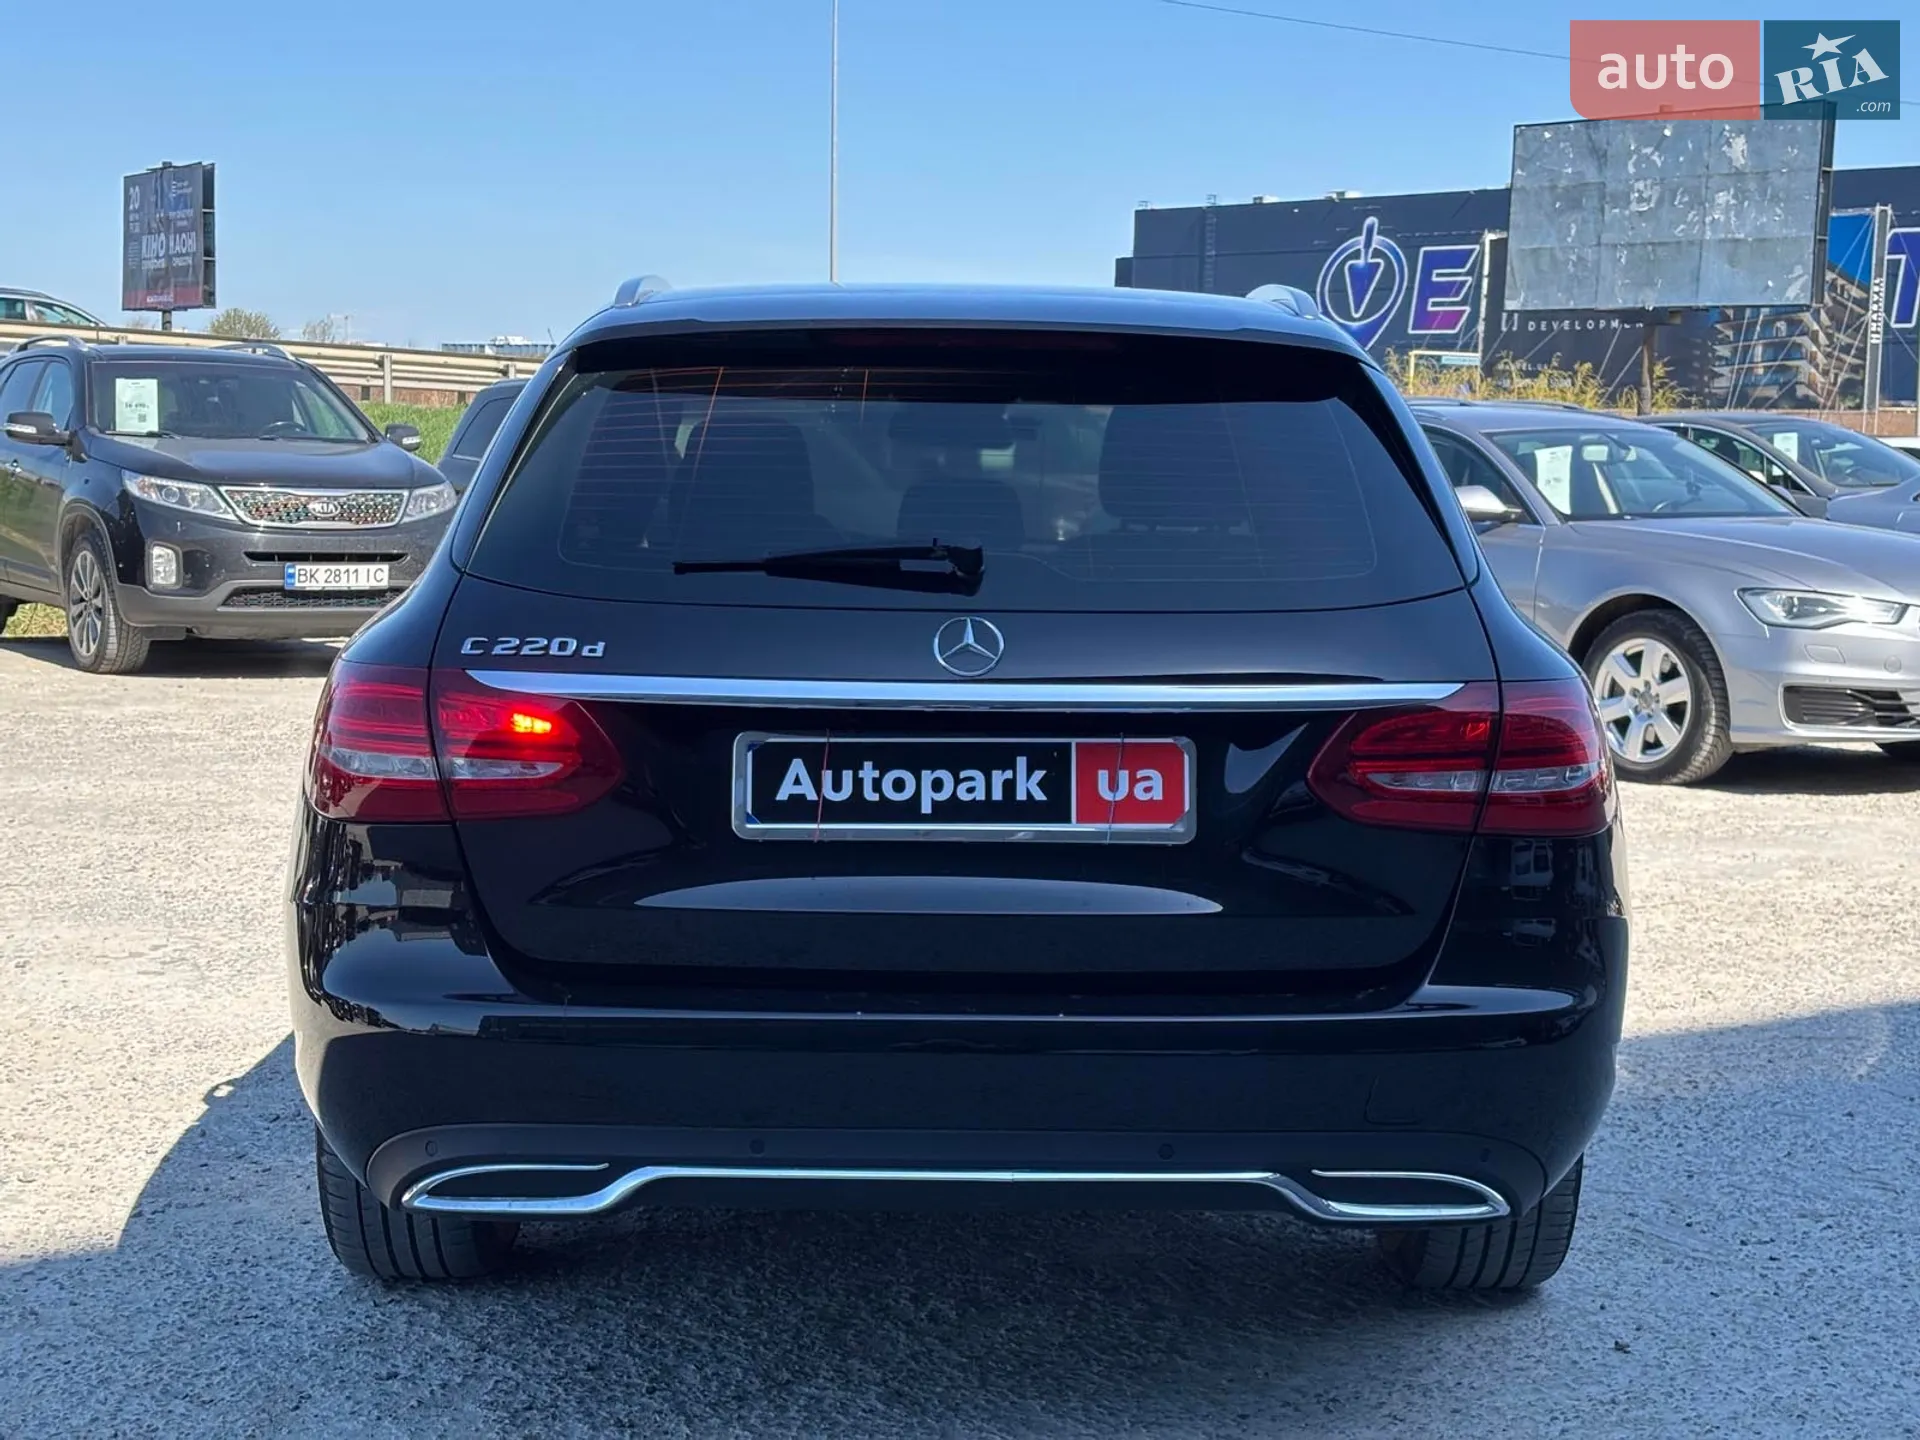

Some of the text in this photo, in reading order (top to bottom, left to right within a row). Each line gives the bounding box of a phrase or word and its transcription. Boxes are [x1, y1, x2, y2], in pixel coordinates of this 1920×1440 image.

[314, 503, 337, 514] KIA
[297, 568, 385, 584] BK 2811 IC
[460, 636, 488, 655] C
[775, 756, 1165, 814] Autopark ua
